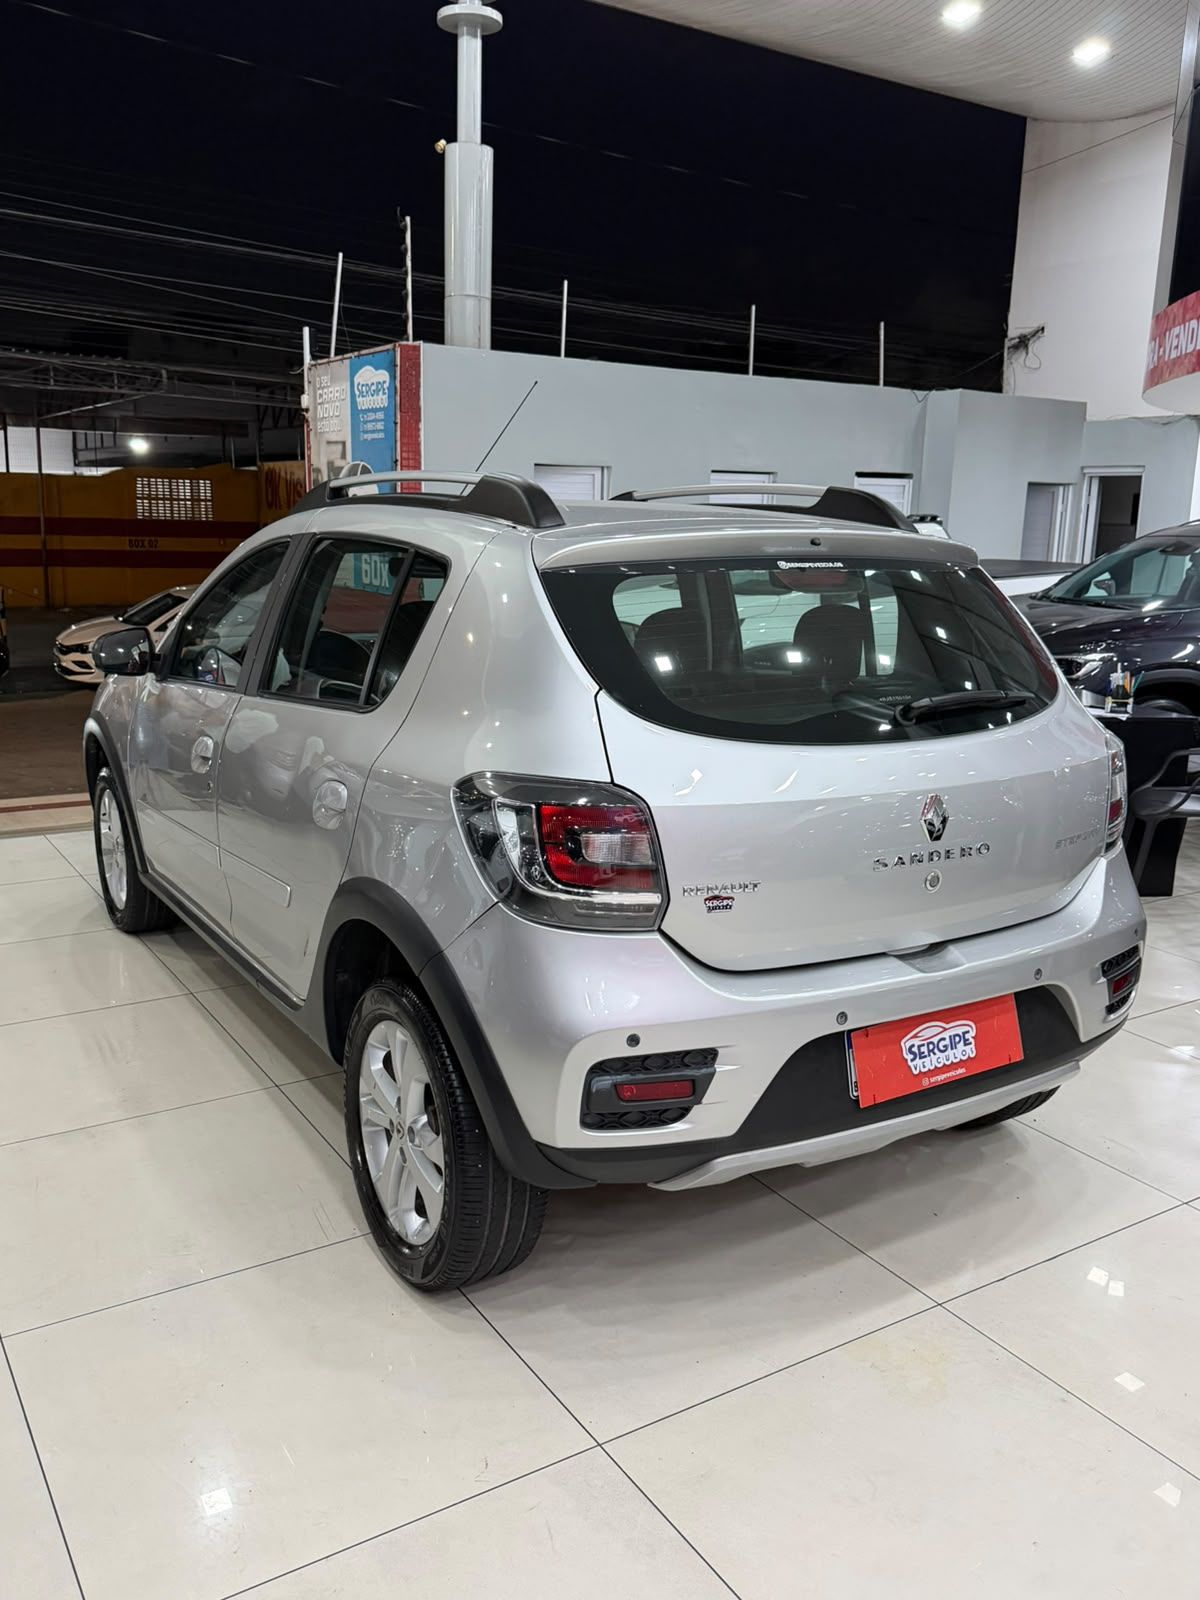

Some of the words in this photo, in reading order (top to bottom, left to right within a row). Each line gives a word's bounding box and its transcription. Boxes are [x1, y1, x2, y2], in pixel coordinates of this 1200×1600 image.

[317, 384, 346, 402] CARRO
[357, 380, 387, 398] SERGIPE
[317, 402, 341, 418] NOVO
[128, 539, 147, 549] BOX
[873, 842, 990, 872] SANDERO
[682, 880, 761, 897] RENAULT
[907, 1030, 972, 1062] SERGIPE
